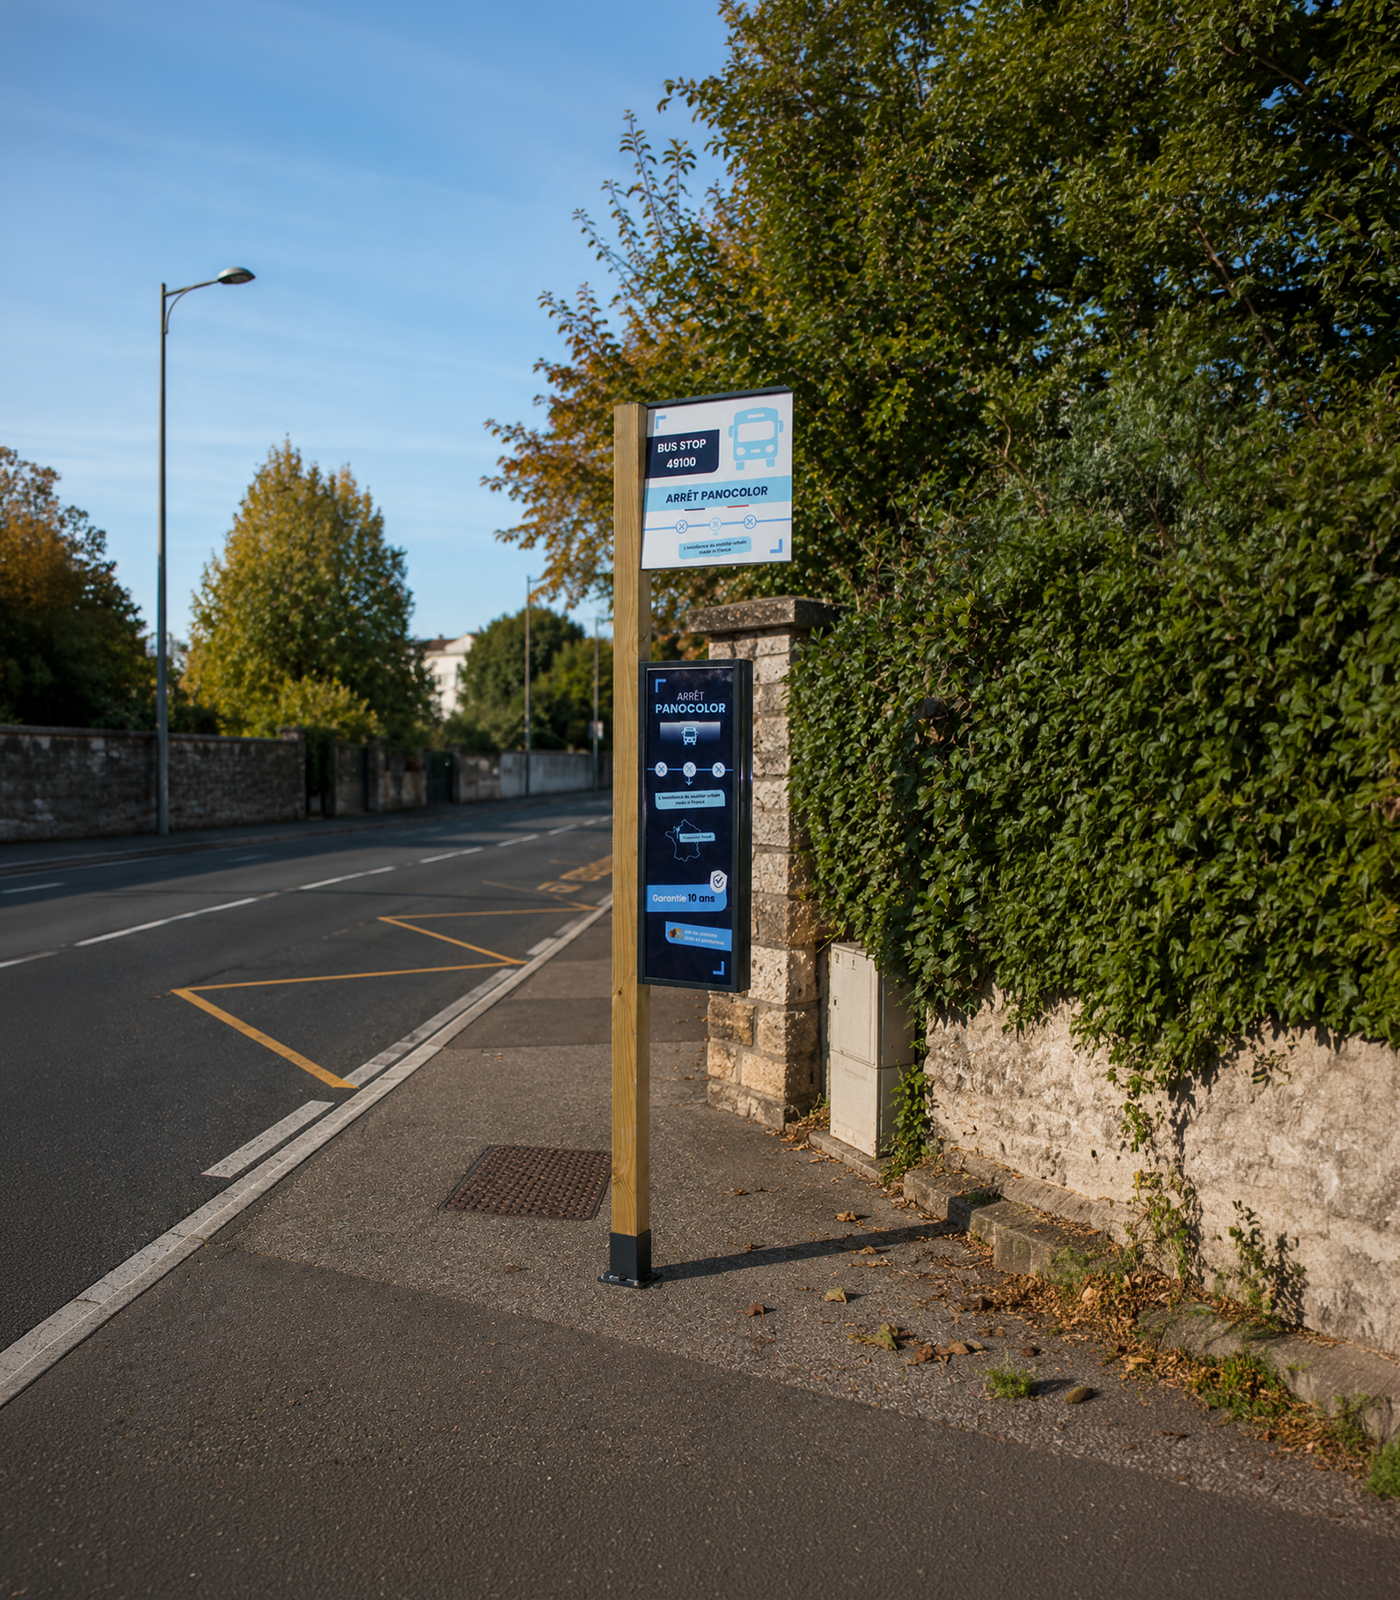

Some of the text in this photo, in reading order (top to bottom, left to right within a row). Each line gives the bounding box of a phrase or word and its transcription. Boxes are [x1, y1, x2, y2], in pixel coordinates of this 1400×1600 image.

[657, 438, 707, 454] BUS STOP
[666, 456, 697, 469] 49100
[701, 485, 769, 501] PANOCOLOR
[655, 703, 726, 714] PANOCOLOR
[687, 893, 697, 902] 10
[698, 895, 716, 903] ans
